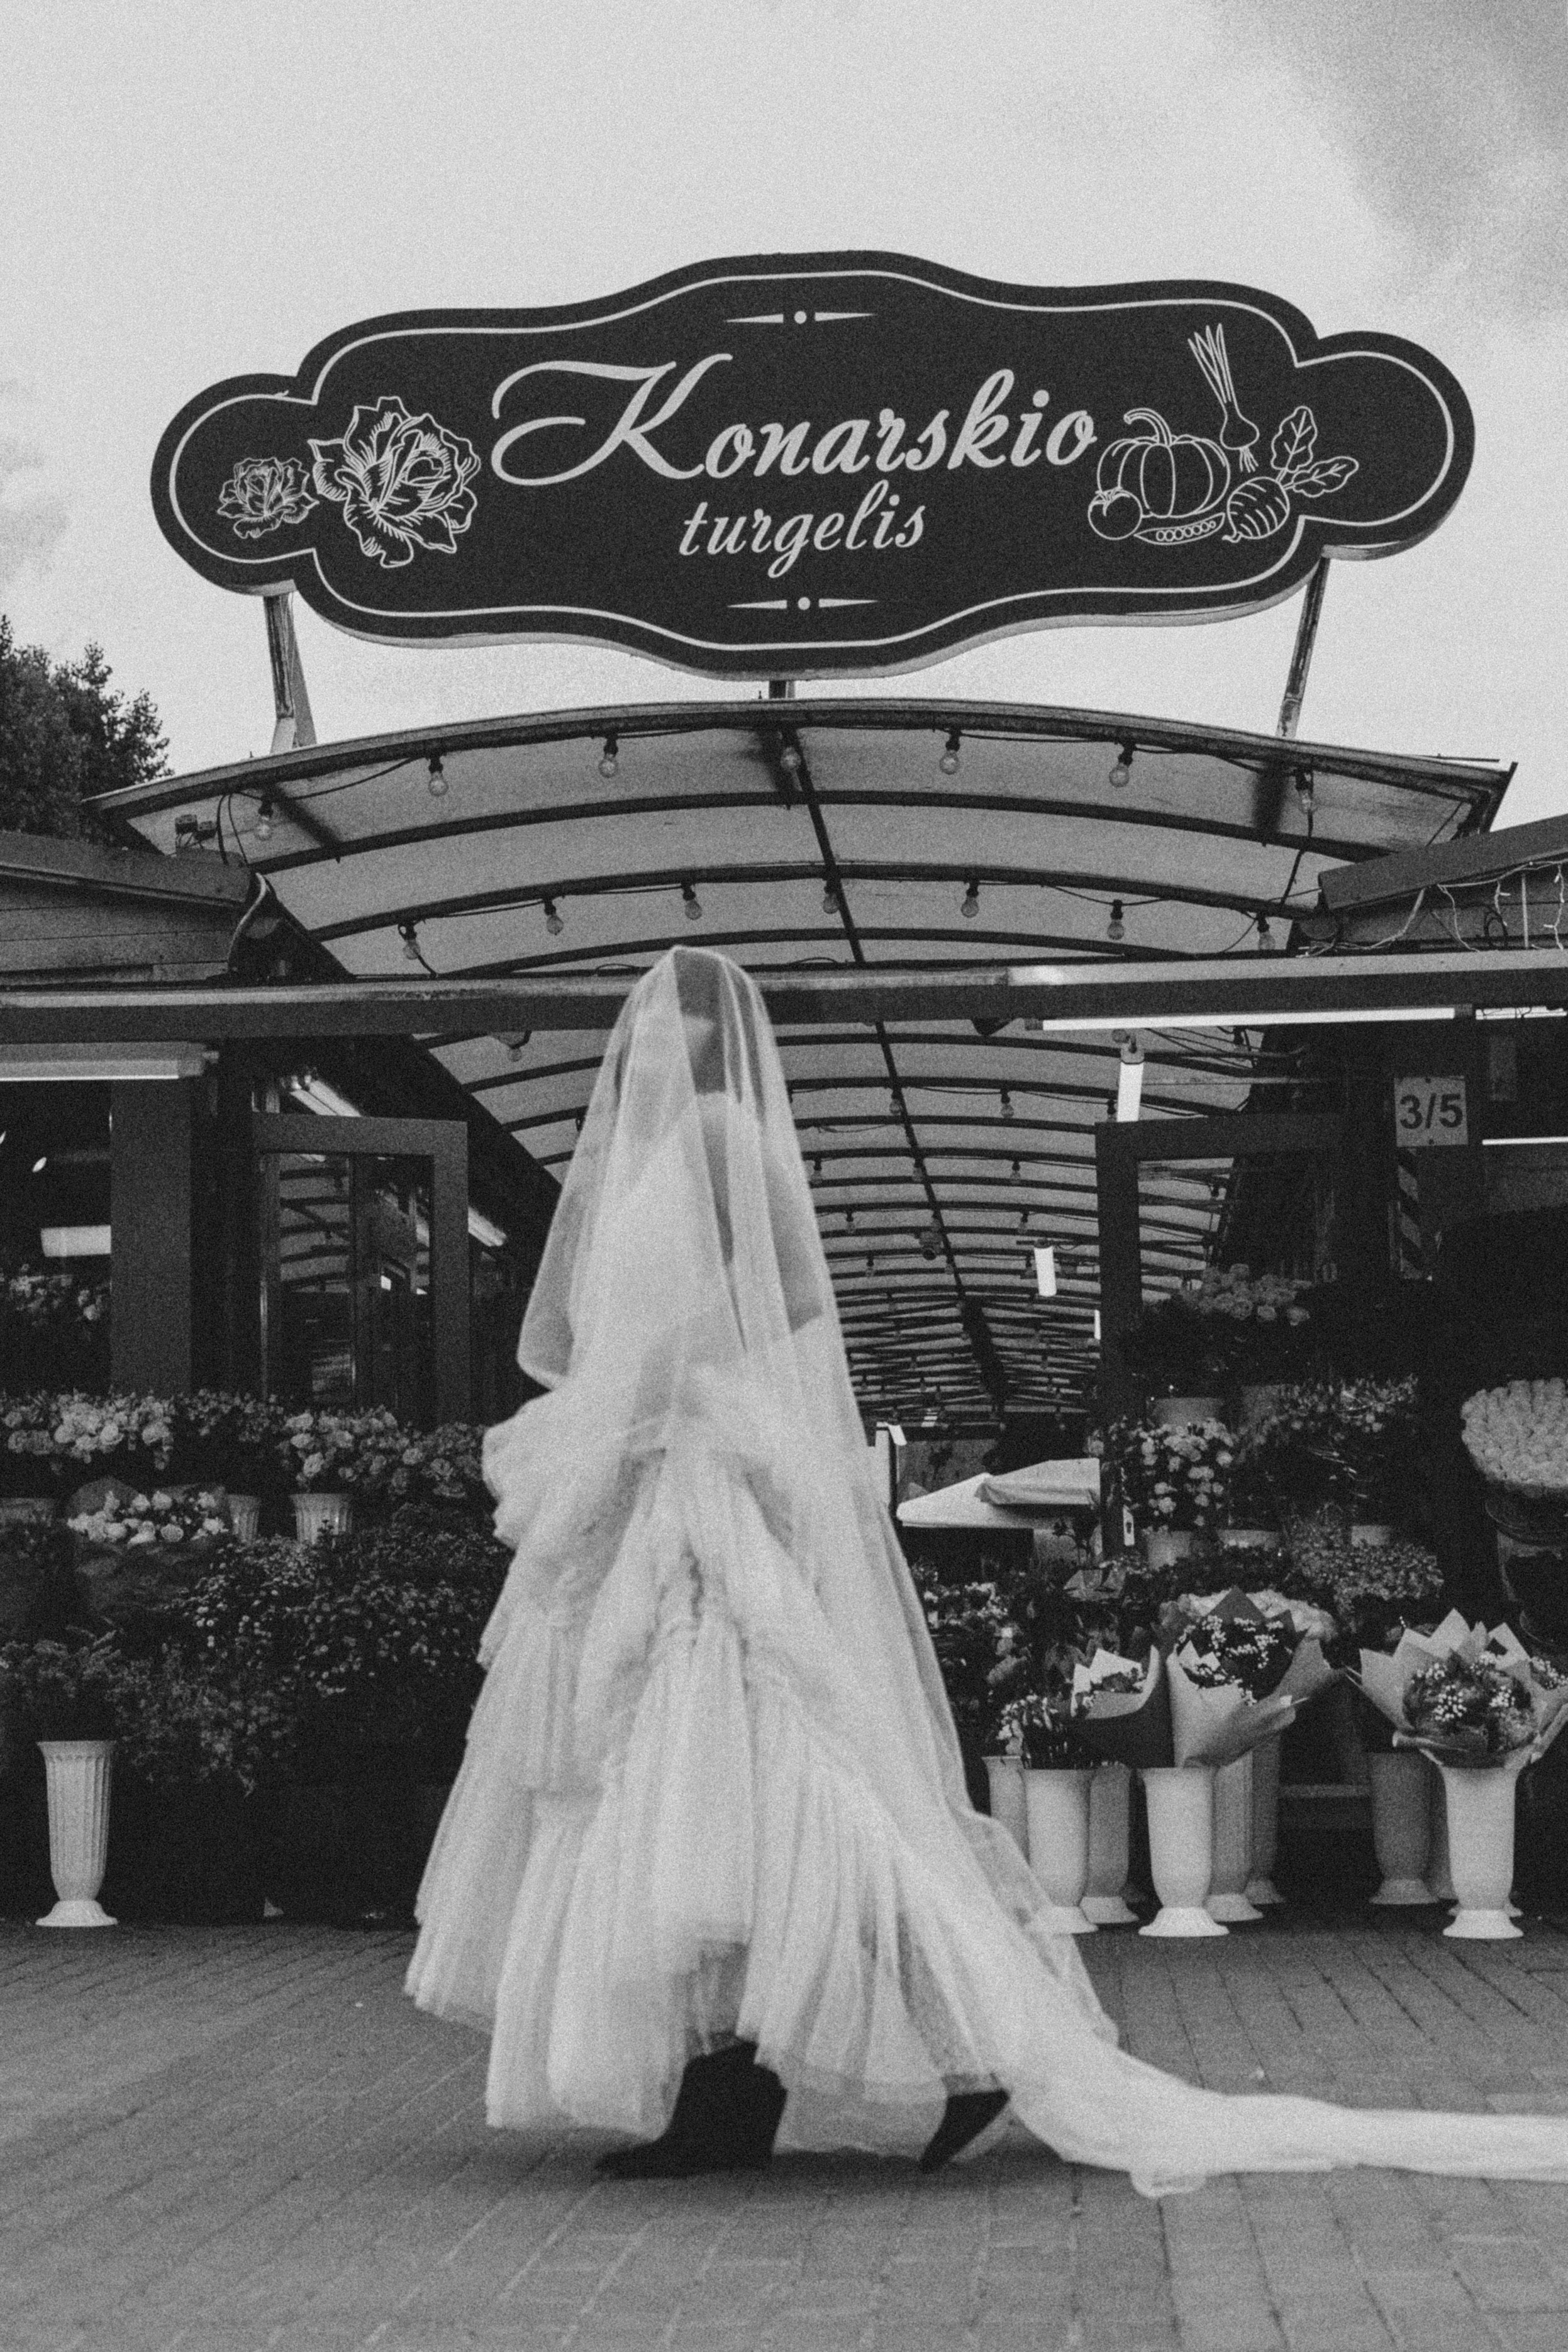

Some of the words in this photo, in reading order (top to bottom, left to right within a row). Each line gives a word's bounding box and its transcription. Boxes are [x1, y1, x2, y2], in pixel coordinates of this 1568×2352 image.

[491, 353, 1097, 486] Konarskio
[678, 479, 926, 578] turgelis
[1399, 1093, 1463, 1129] 3/5
